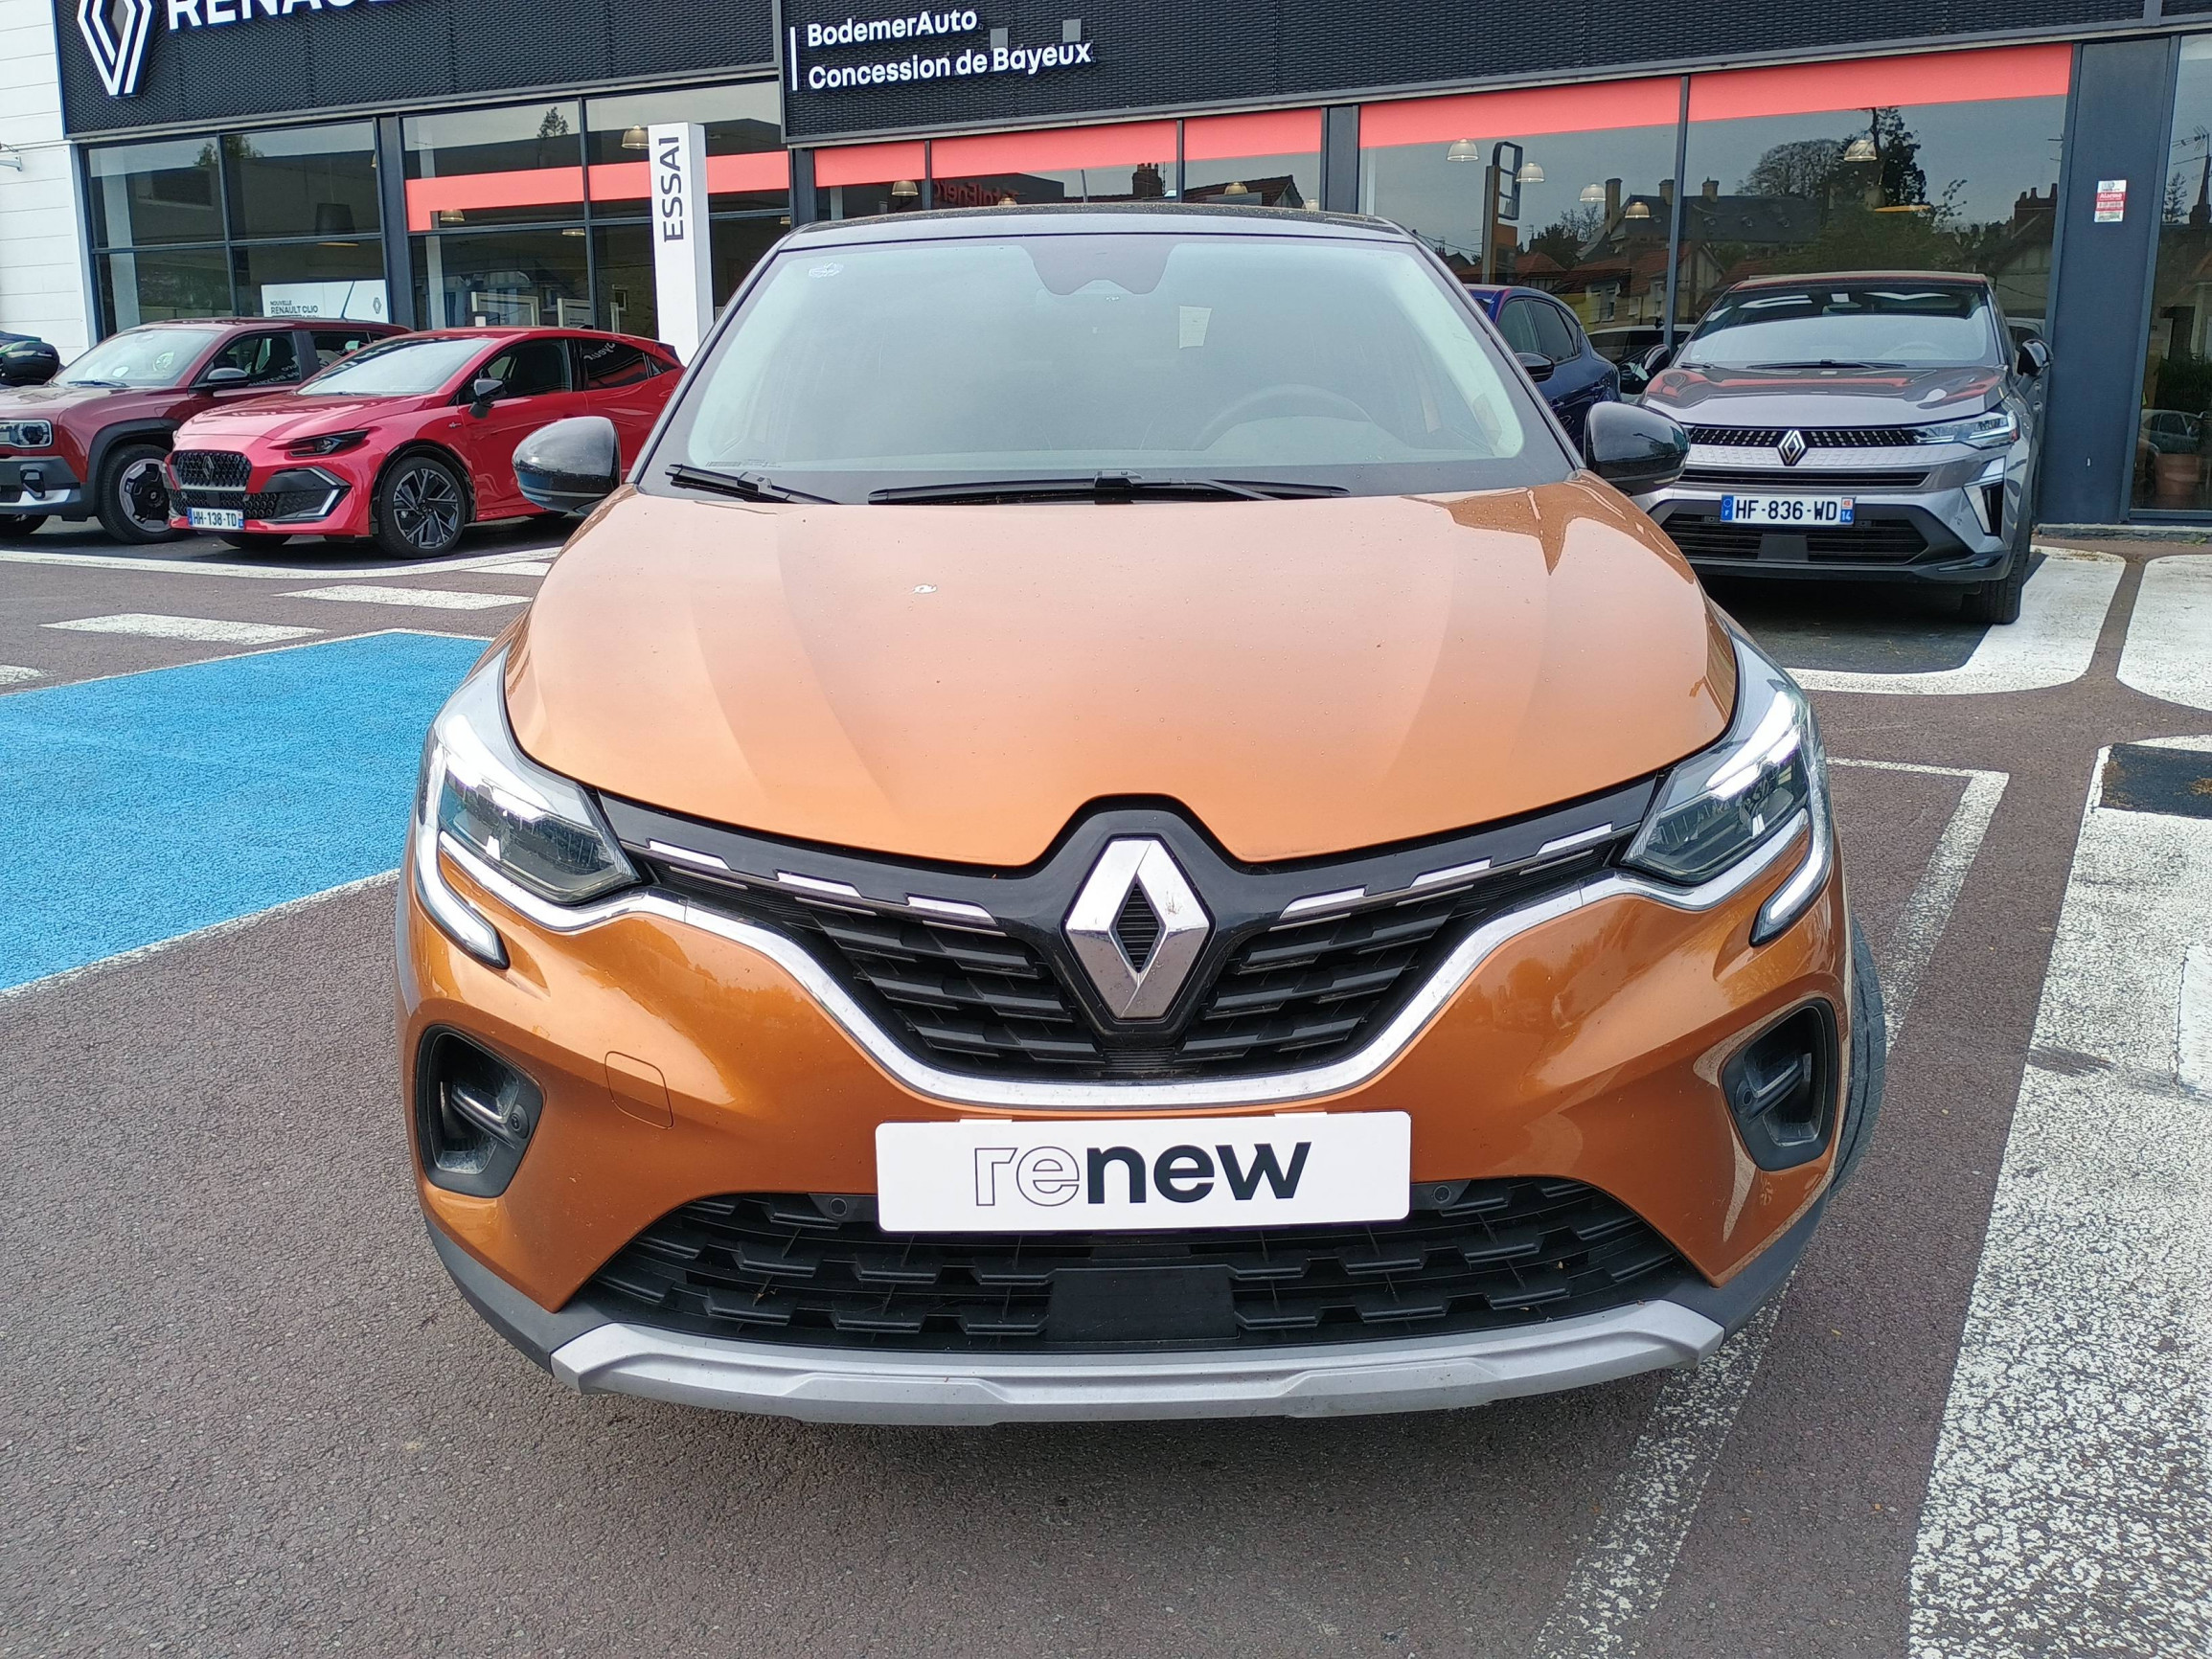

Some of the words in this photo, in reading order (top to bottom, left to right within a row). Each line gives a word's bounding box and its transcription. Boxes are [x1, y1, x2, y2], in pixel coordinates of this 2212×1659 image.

[807, 9, 978, 47] BodemerAuto
[809, 55, 951, 89] Concession
[955, 49, 988, 76] de
[992, 42, 1092, 75] Bayeux
[658, 137, 684, 242] ESSAI
[271, 306, 301, 314] RENAULT
[302, 305, 319, 313] CLIO
[1735, 499, 1837, 521] HF-836-WD
[1841, 511, 1852, 521] 14
[974, 1141, 1311, 1207] renew
